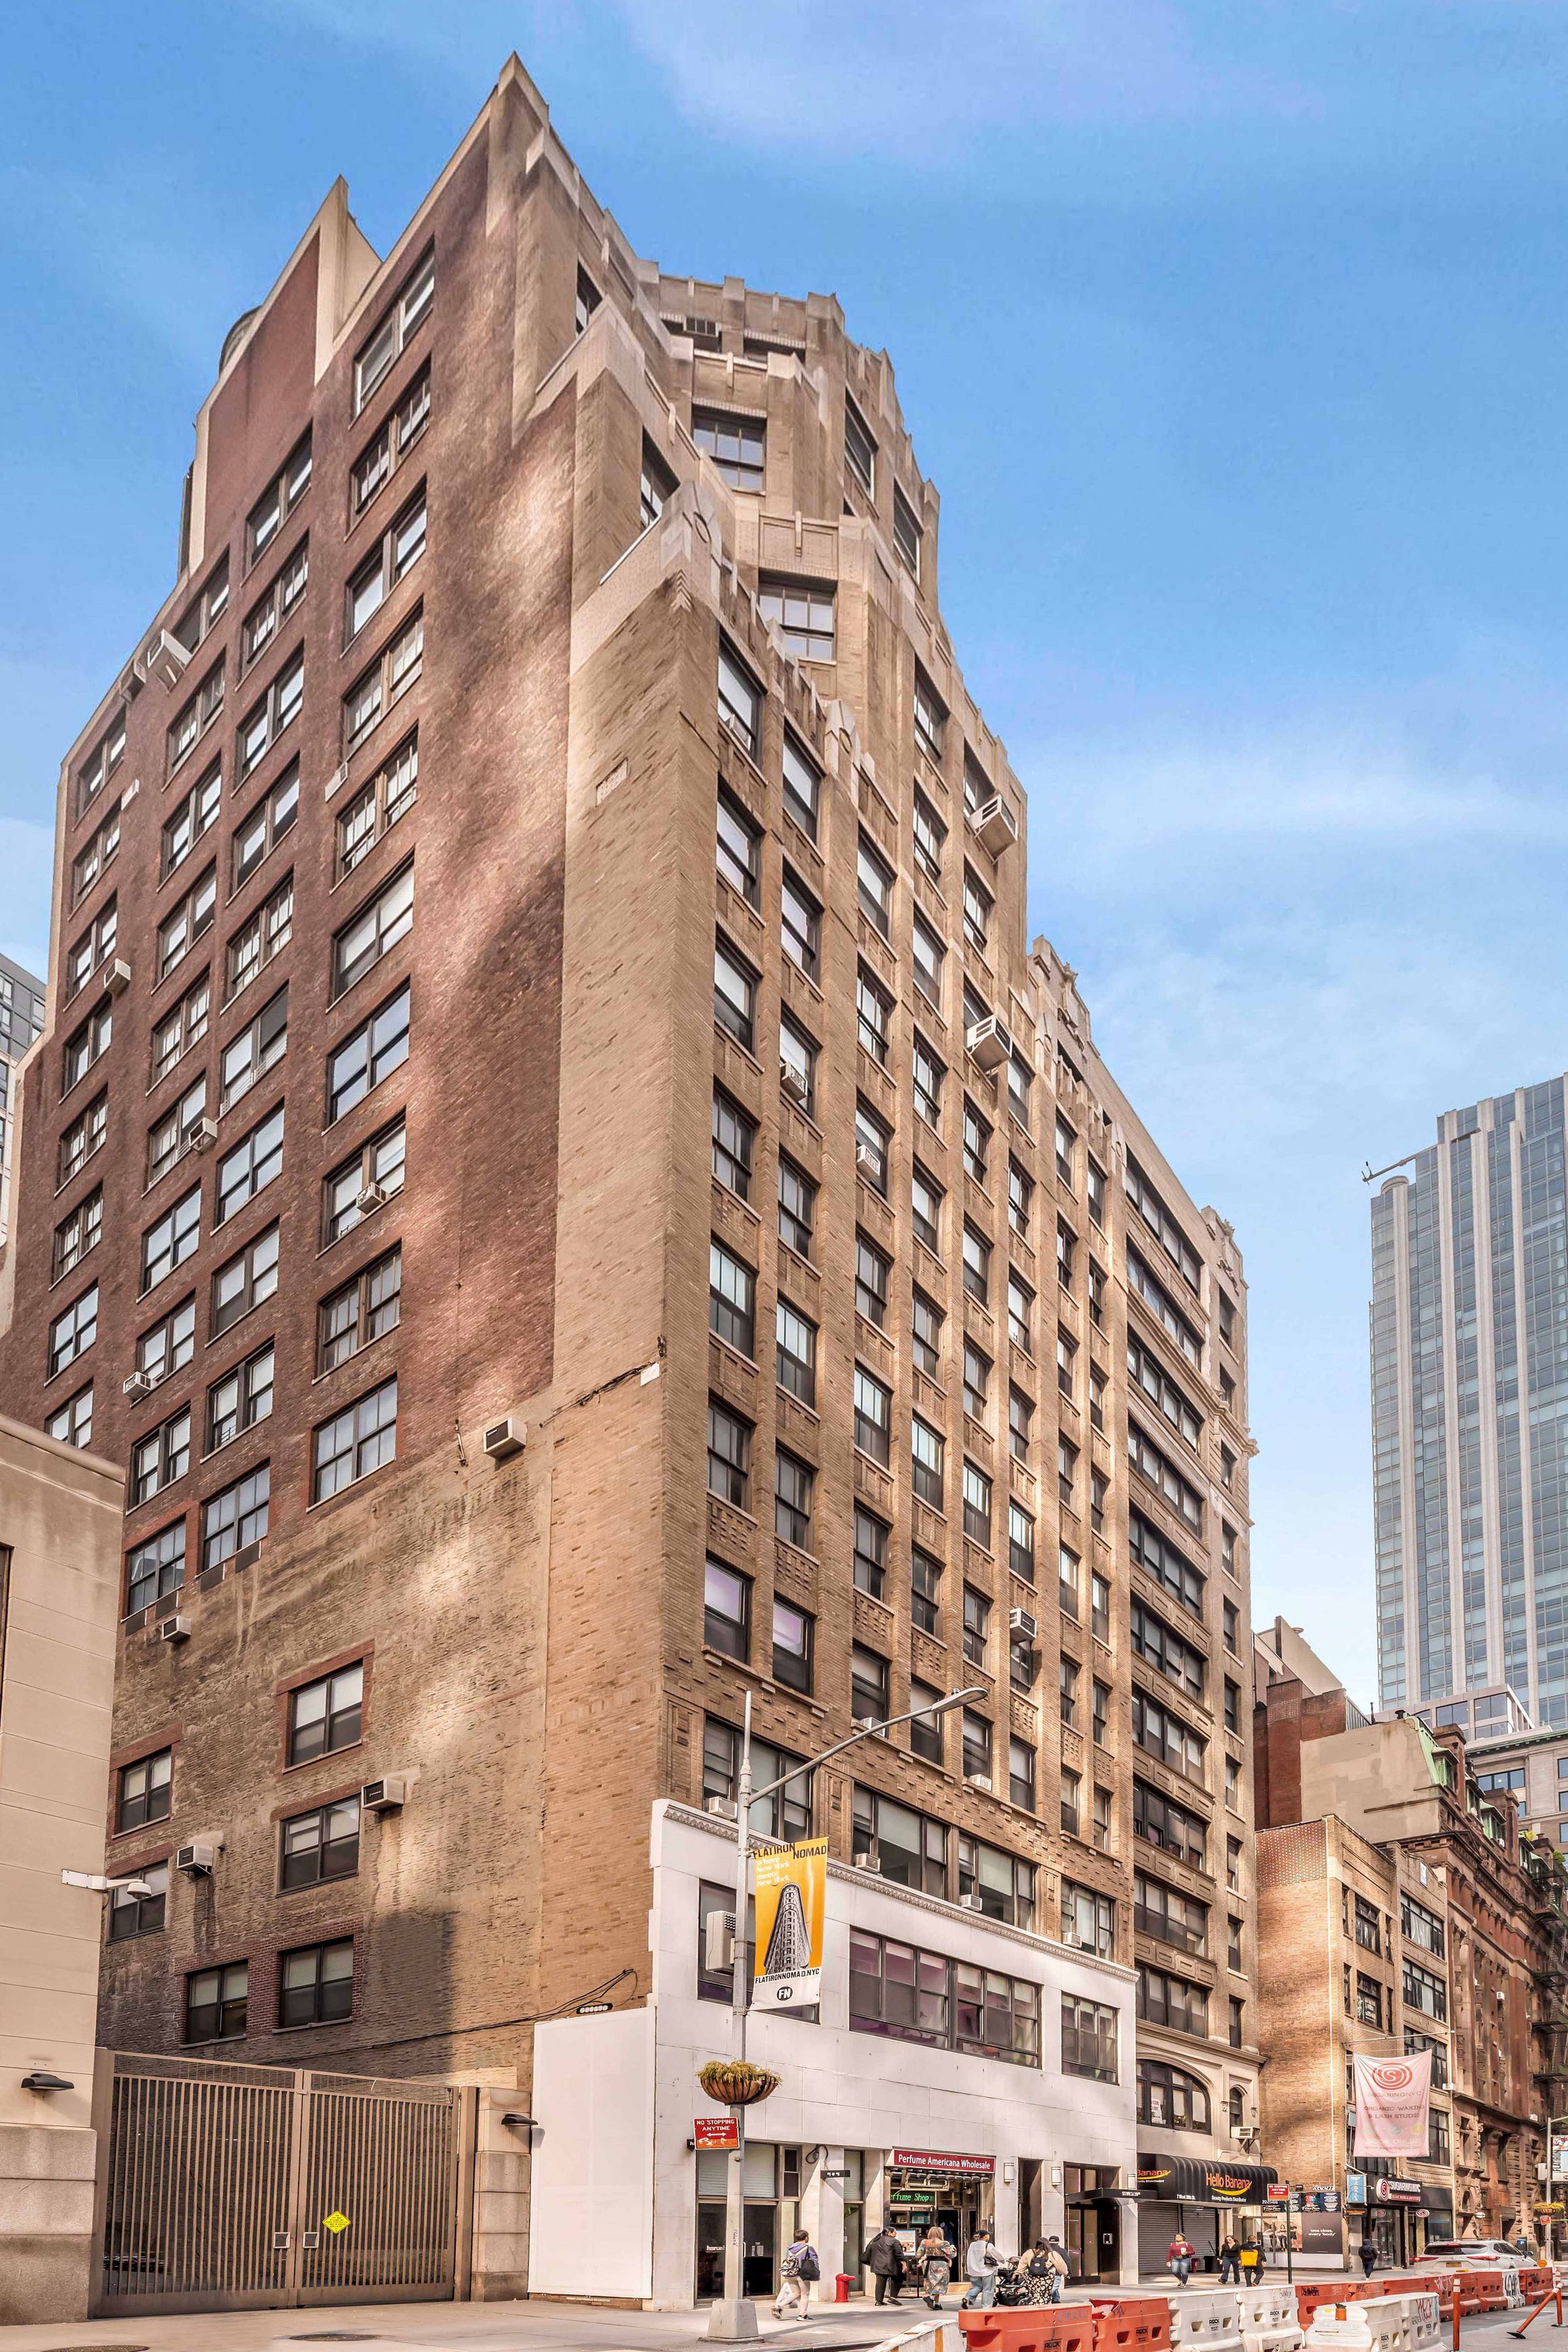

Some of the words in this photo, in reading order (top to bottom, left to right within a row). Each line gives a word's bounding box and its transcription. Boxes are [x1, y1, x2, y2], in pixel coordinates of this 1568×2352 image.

[753, 1842, 795, 1859] FLATIRON
[793, 1844, 826, 1859] NOMAD
[757, 1870, 778, 1880] meets
[774, 1874, 790, 1883] York
[755, 1968, 820, 1984] FLATIRONNOMAD.NYC
[778, 1988, 791, 1999] FN
[898, 2154, 926, 2166] Perfume
[928, 2156, 960, 2168] Americana
[961, 2159, 990, 2170] Wholesale
[1205, 2172, 1224, 2187] Hello
[1225, 2174, 1250, 2189] Banana
[890, 2192, 911, 2201] rfume
[914, 2193, 929, 2202] Shop
